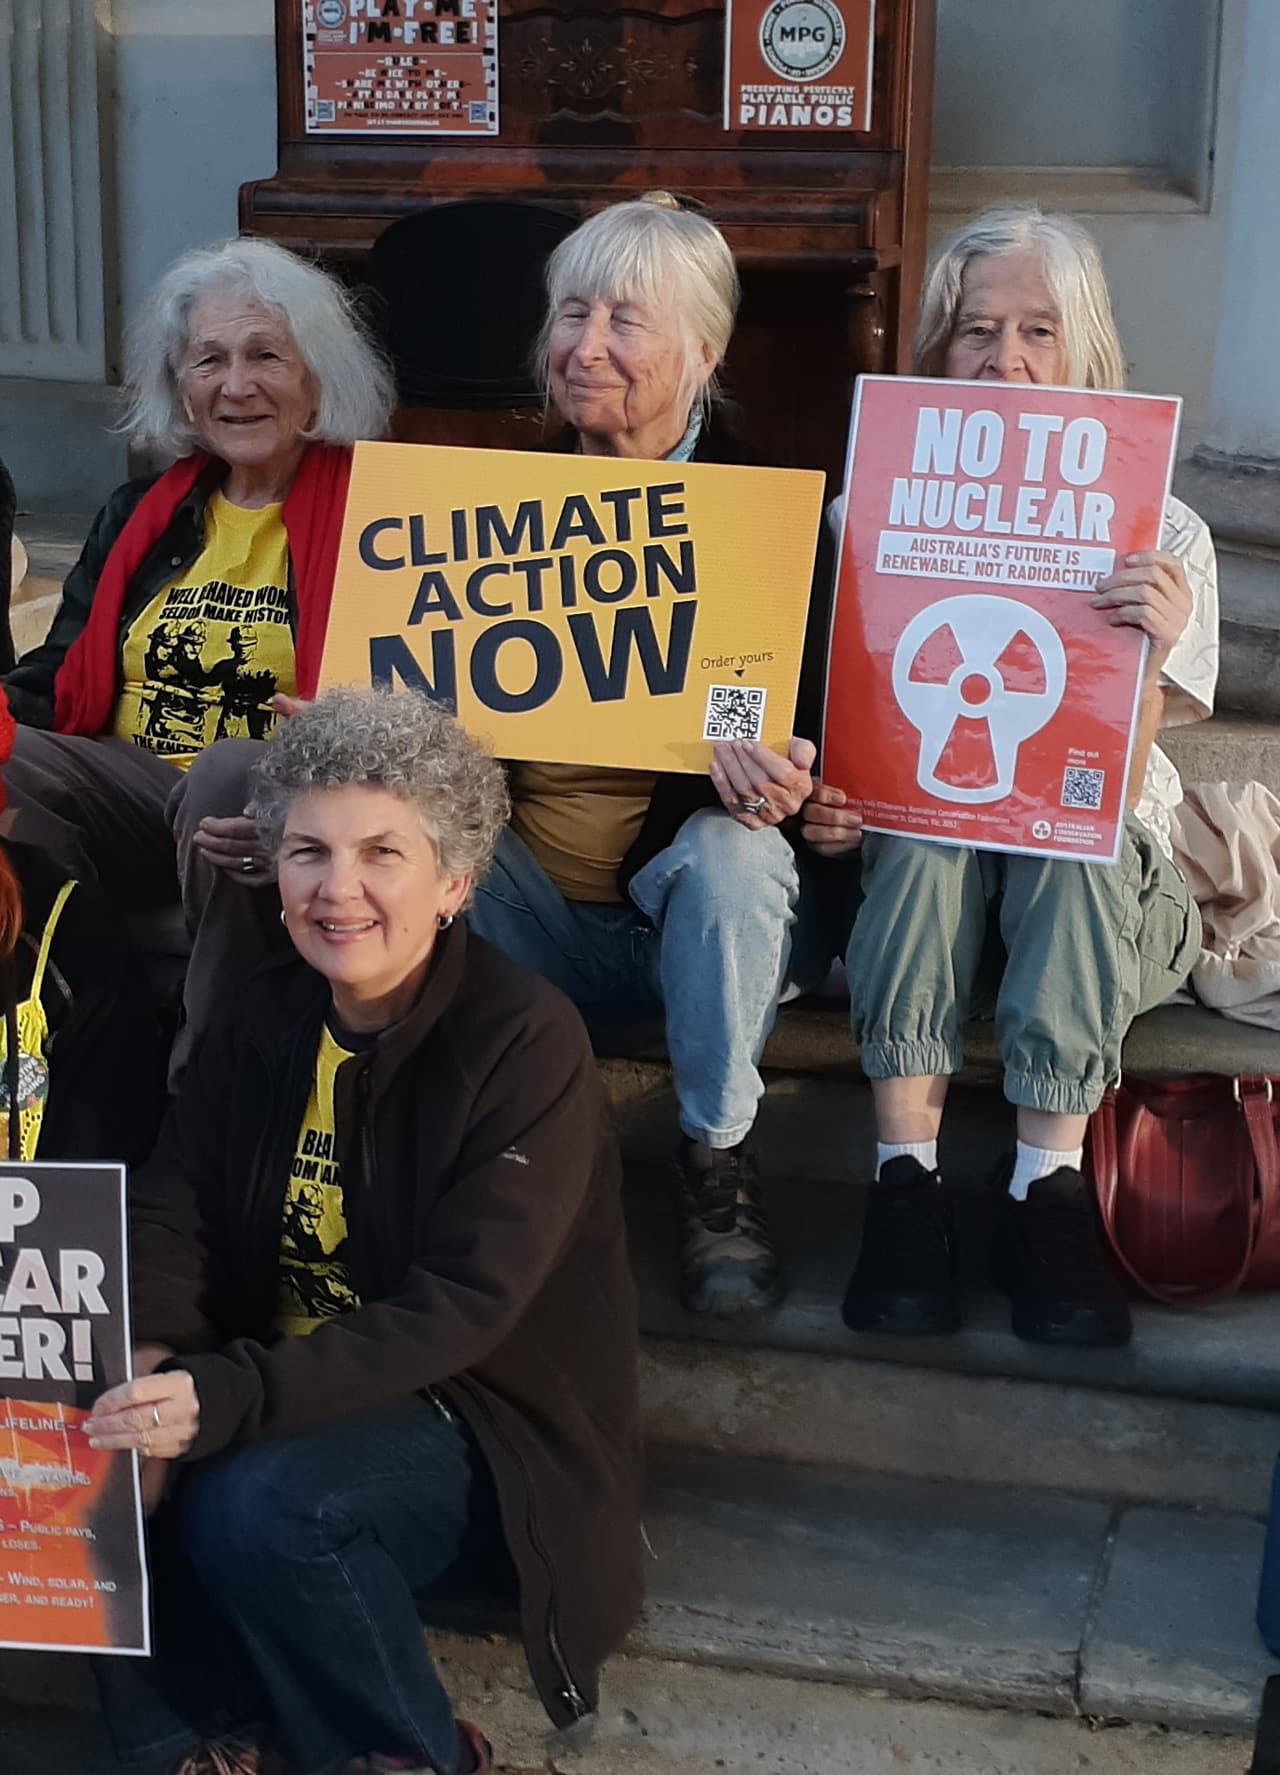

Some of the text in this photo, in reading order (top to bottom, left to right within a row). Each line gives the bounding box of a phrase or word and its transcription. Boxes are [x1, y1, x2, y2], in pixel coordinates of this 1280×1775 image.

[779, 26, 826, 42] MPG
[742, 94, 854, 105] PLAYABLE PUBLIC
[740, 105, 853, 127] PIANOS
[911, 406, 1108, 487] NO TO
[888, 477, 1116, 543] NUCLEAR
[358, 481, 689, 571] CLIMATE
[909, 537, 1080, 565] AUSTRALIA'S FUTURE IS
[882, 553, 969, 577] RENEWABLE,
[974, 562, 1003, 578] NOT
[406, 540, 698, 627] ACTION
[202, 602, 243, 622] MAKE
[369, 600, 699, 717] NOW
[700, 650, 775, 670] Order yours
[2, 1540, 42, 1551] LOSES.
[94, 1580, 117, 1592] AND
[25, 1594, 49, 1606] AND
[51, 1595, 94, 1609] READY!
